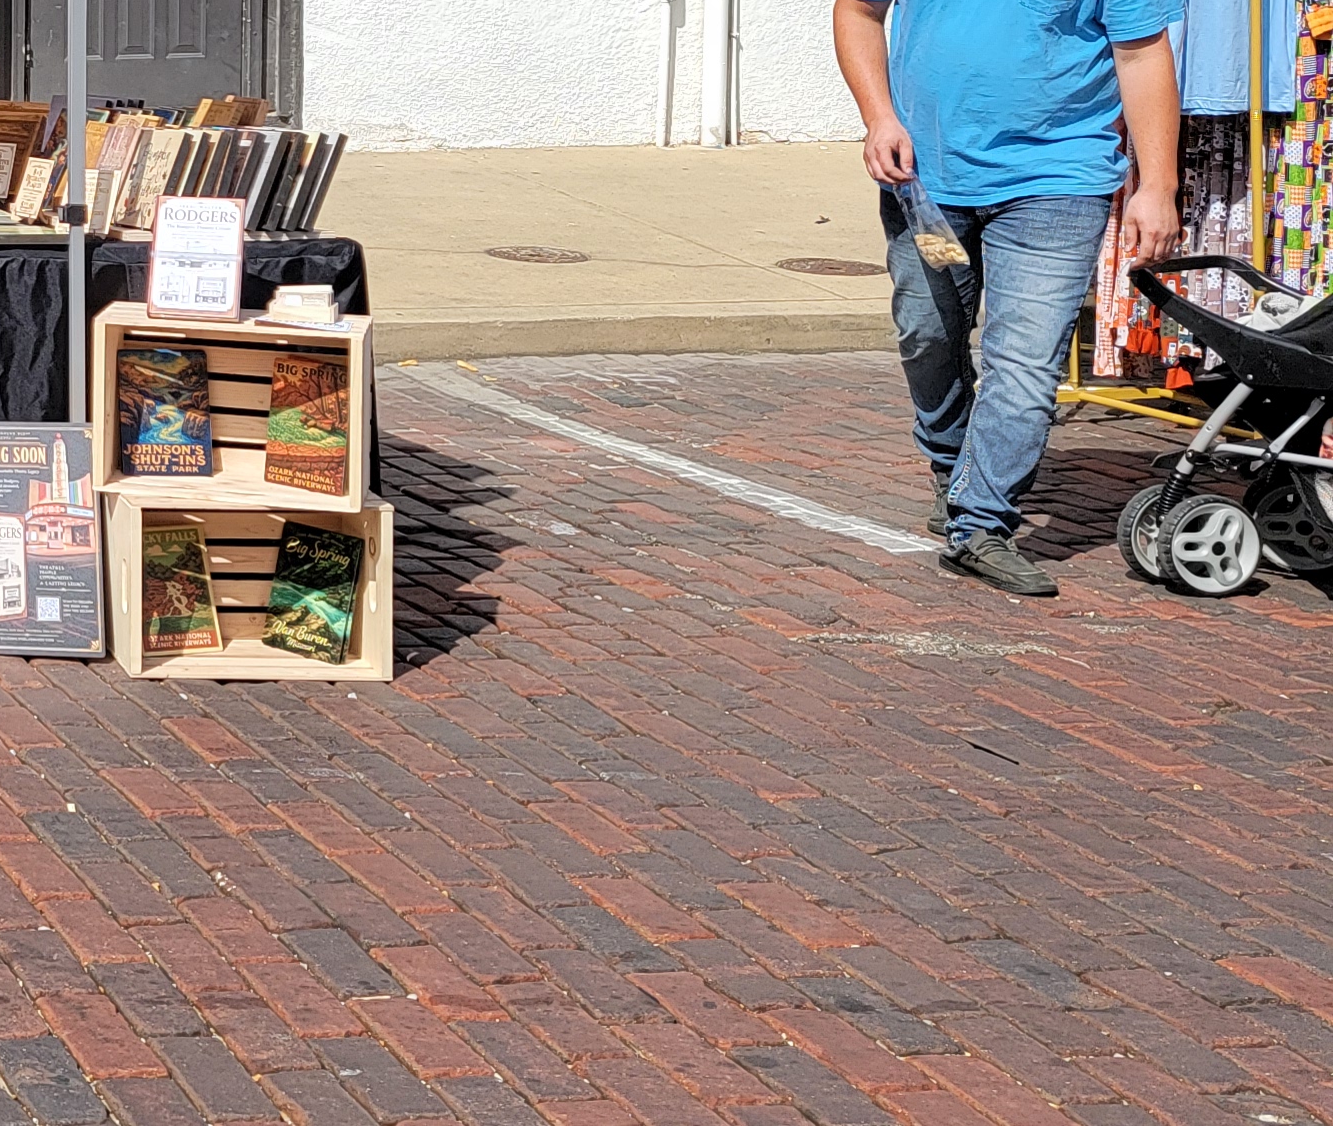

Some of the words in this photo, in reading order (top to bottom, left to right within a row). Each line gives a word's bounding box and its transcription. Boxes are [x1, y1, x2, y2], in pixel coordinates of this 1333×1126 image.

[164, 207, 237, 224] RODGERS
[277, 362, 299, 376] BIG
[302, 366, 347, 384] SPRING
[13, 446, 47, 465] SOON
[123, 443, 205, 455] JOHNSON'S
[130, 454, 206, 466] SHUT-INS
[172, 465, 199, 473] PARK
[268, 466, 294, 478] OZARK
[294, 470, 335, 485] NATIONAL
[267, 473, 292, 484] SCENIC
[293, 478, 336, 493] RIVERWAYS
[144, 532, 164, 543] CKY
[165, 530, 197, 542] FALLS
[285, 535, 309, 559] Big
[309, 540, 351, 570] Spring
[148, 633, 174, 643] OZARK
[175, 632, 212, 642] NATIONAL
[273, 620, 295, 637] Van
[296, 625, 332, 648] Buren
[149, 640, 172, 649] SCENIC
[173, 638, 212, 648] RIVERWAYS
[286, 637, 316, 652] Missouri
